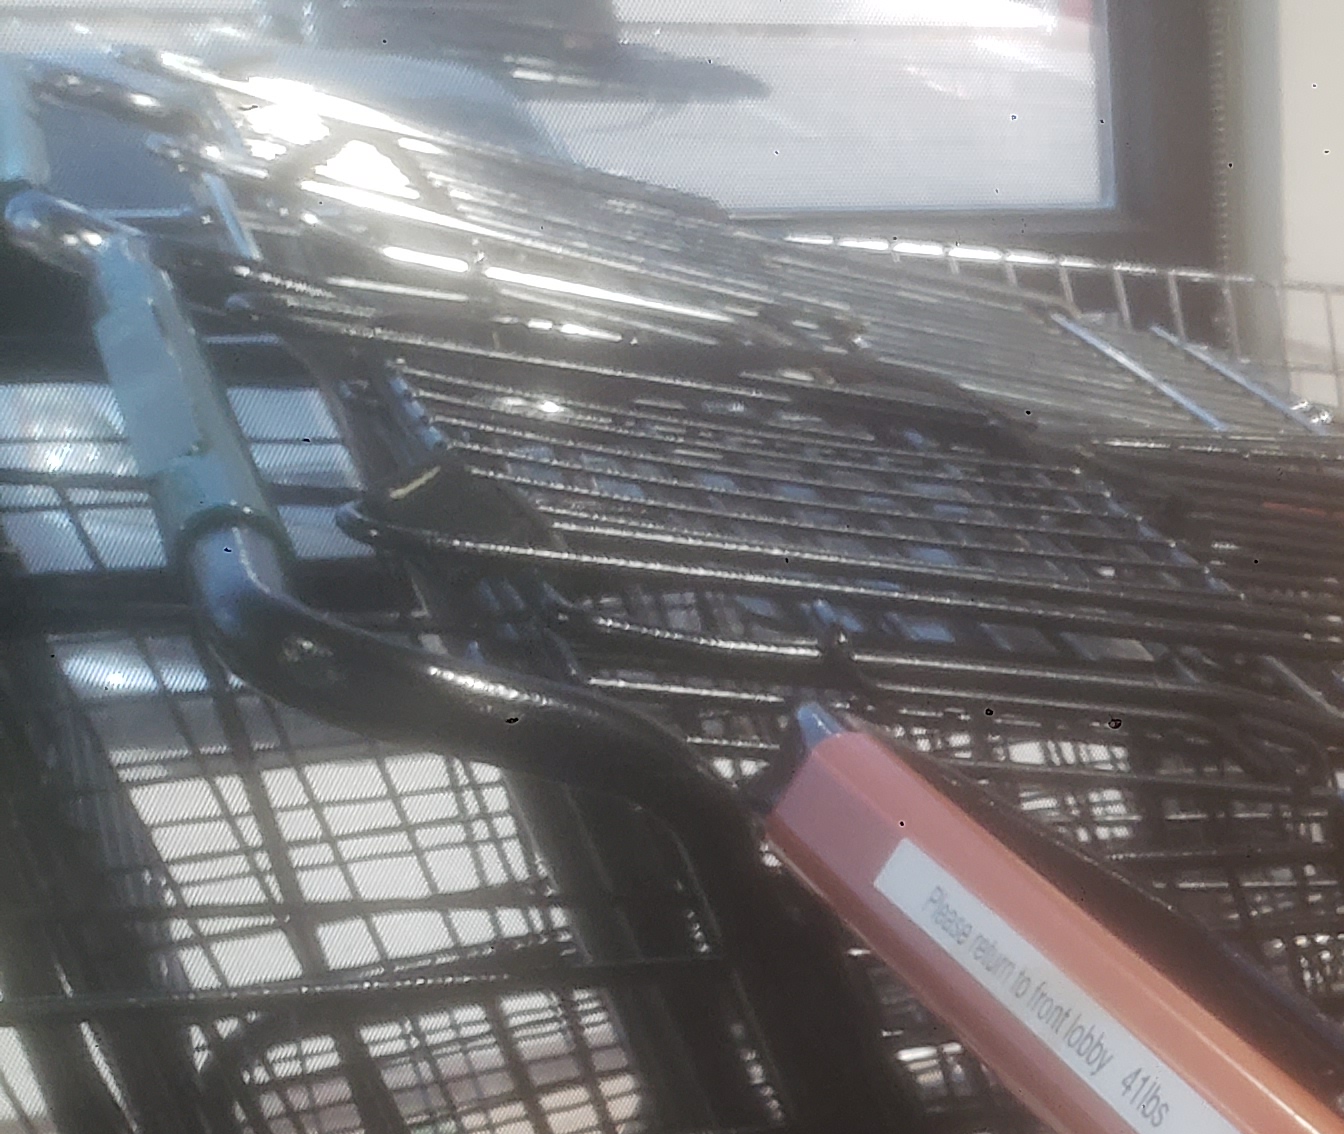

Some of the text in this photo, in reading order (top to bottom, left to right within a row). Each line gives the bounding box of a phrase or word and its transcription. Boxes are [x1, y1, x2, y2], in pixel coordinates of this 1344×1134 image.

[922, 885, 1170, 1128] Please return to front lobby 41lbs
